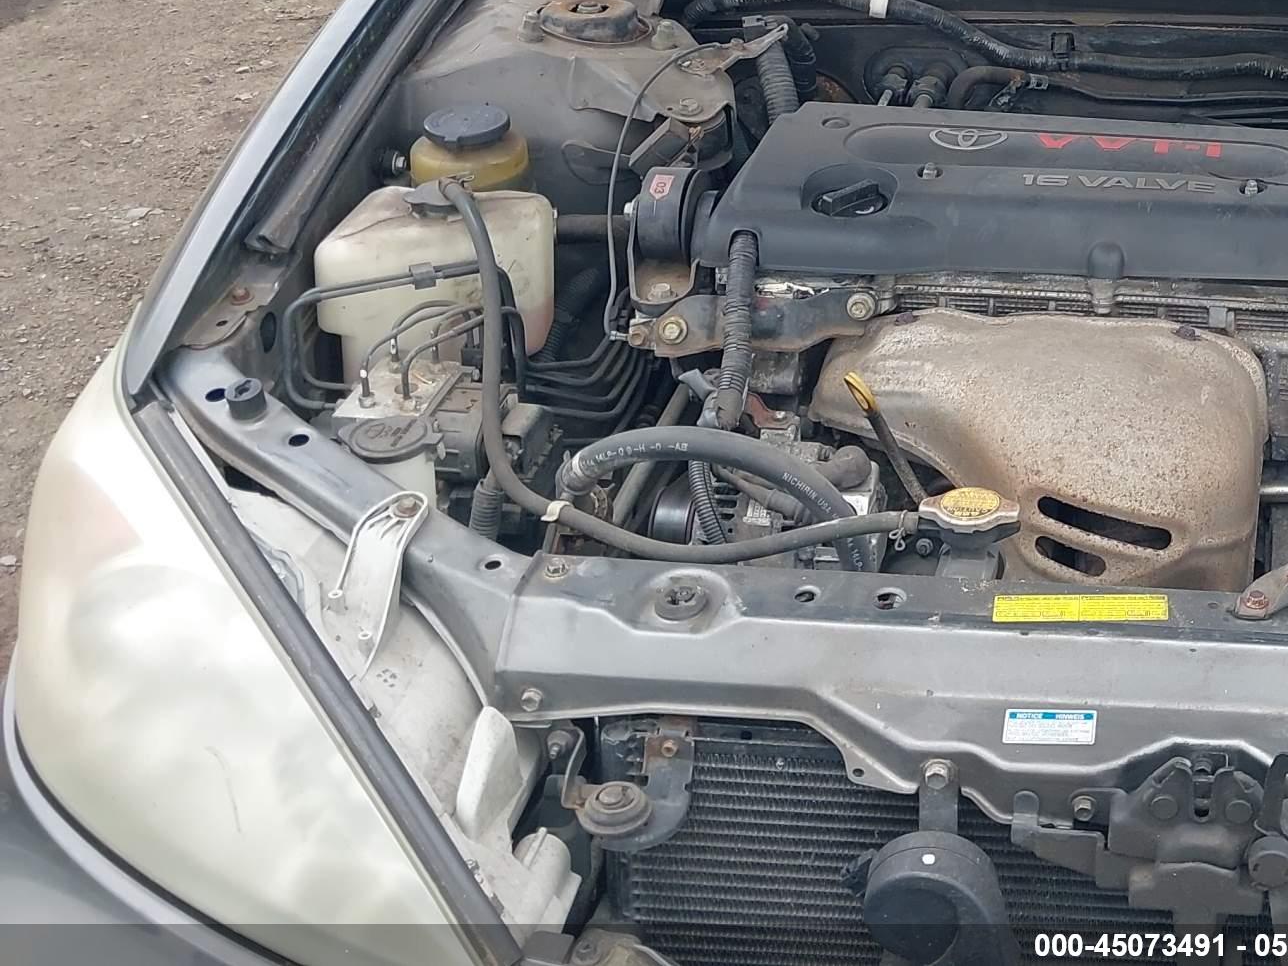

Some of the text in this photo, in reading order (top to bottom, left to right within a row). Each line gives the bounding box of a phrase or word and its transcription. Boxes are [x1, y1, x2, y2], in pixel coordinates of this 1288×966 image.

[654, 181, 666, 194] 03
[1022, 173, 1217, 194] 16 VALVE
[782, 471, 818, 500] NICHIRIN
